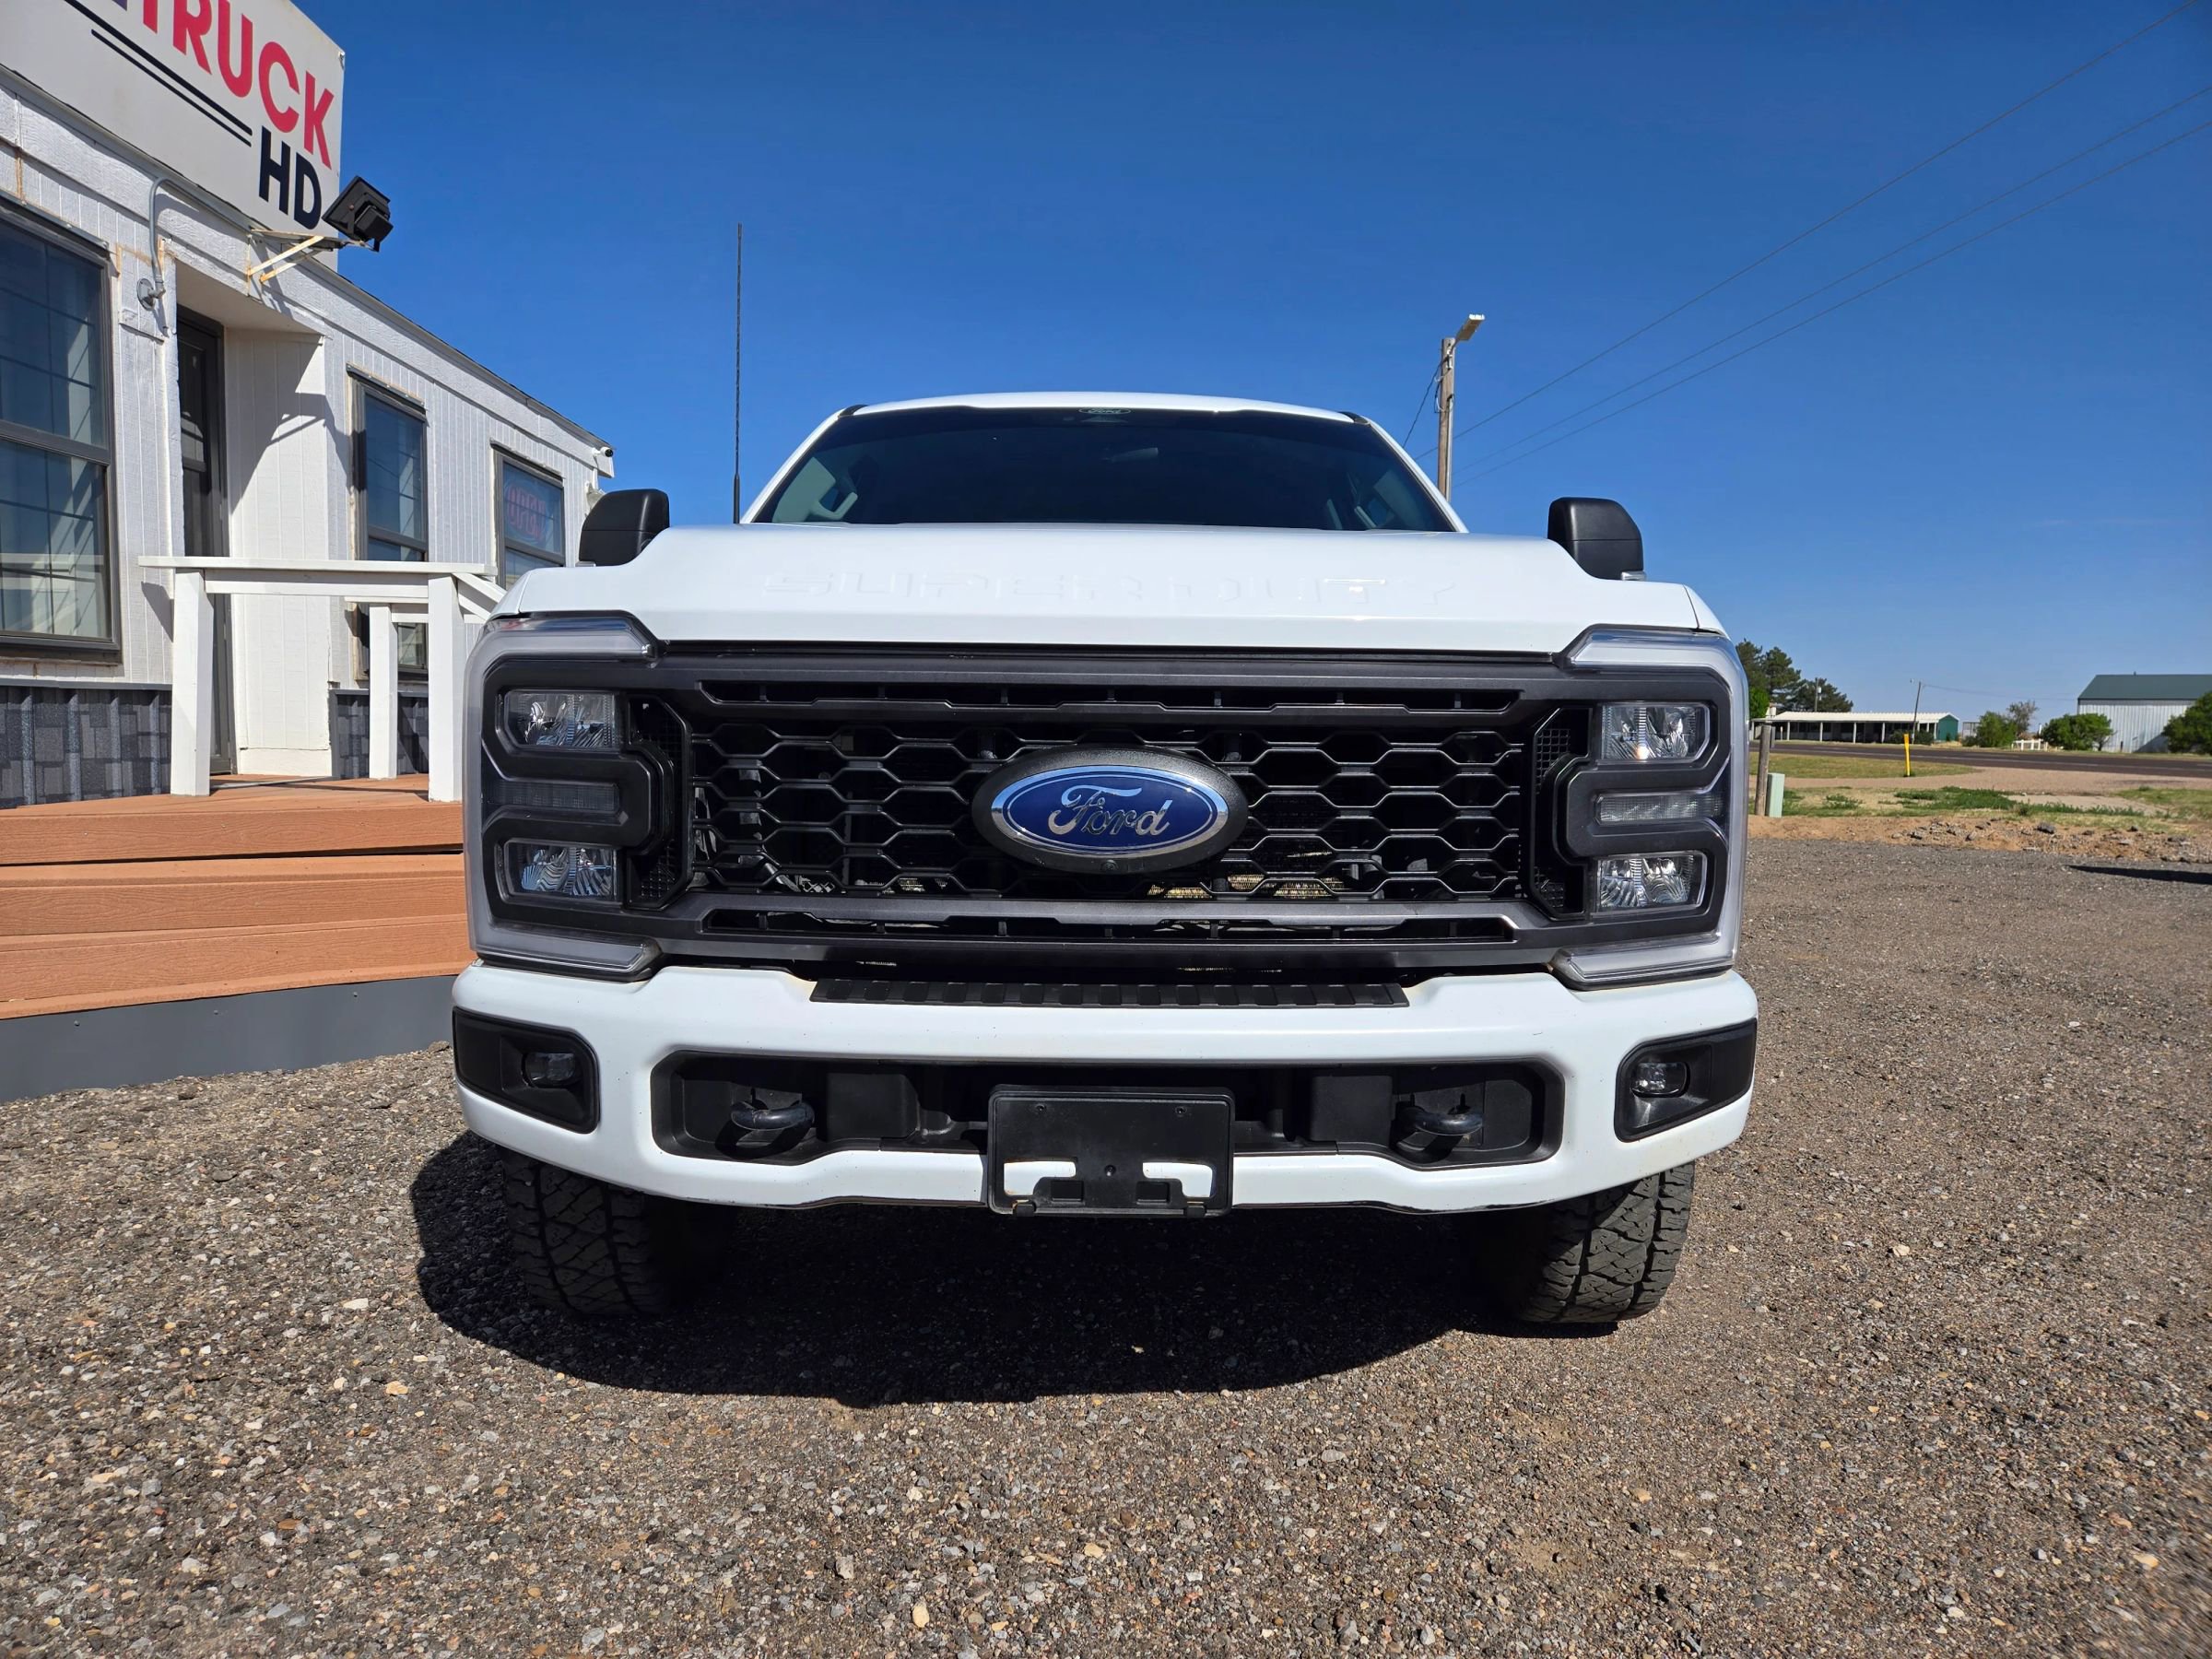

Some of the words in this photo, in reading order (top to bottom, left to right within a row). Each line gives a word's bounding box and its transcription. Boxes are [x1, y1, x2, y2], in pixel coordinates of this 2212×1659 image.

[258, 125, 323, 229] HD
[761, 571, 1144, 601] SUPER
[1048, 784, 1172, 835] Ford
